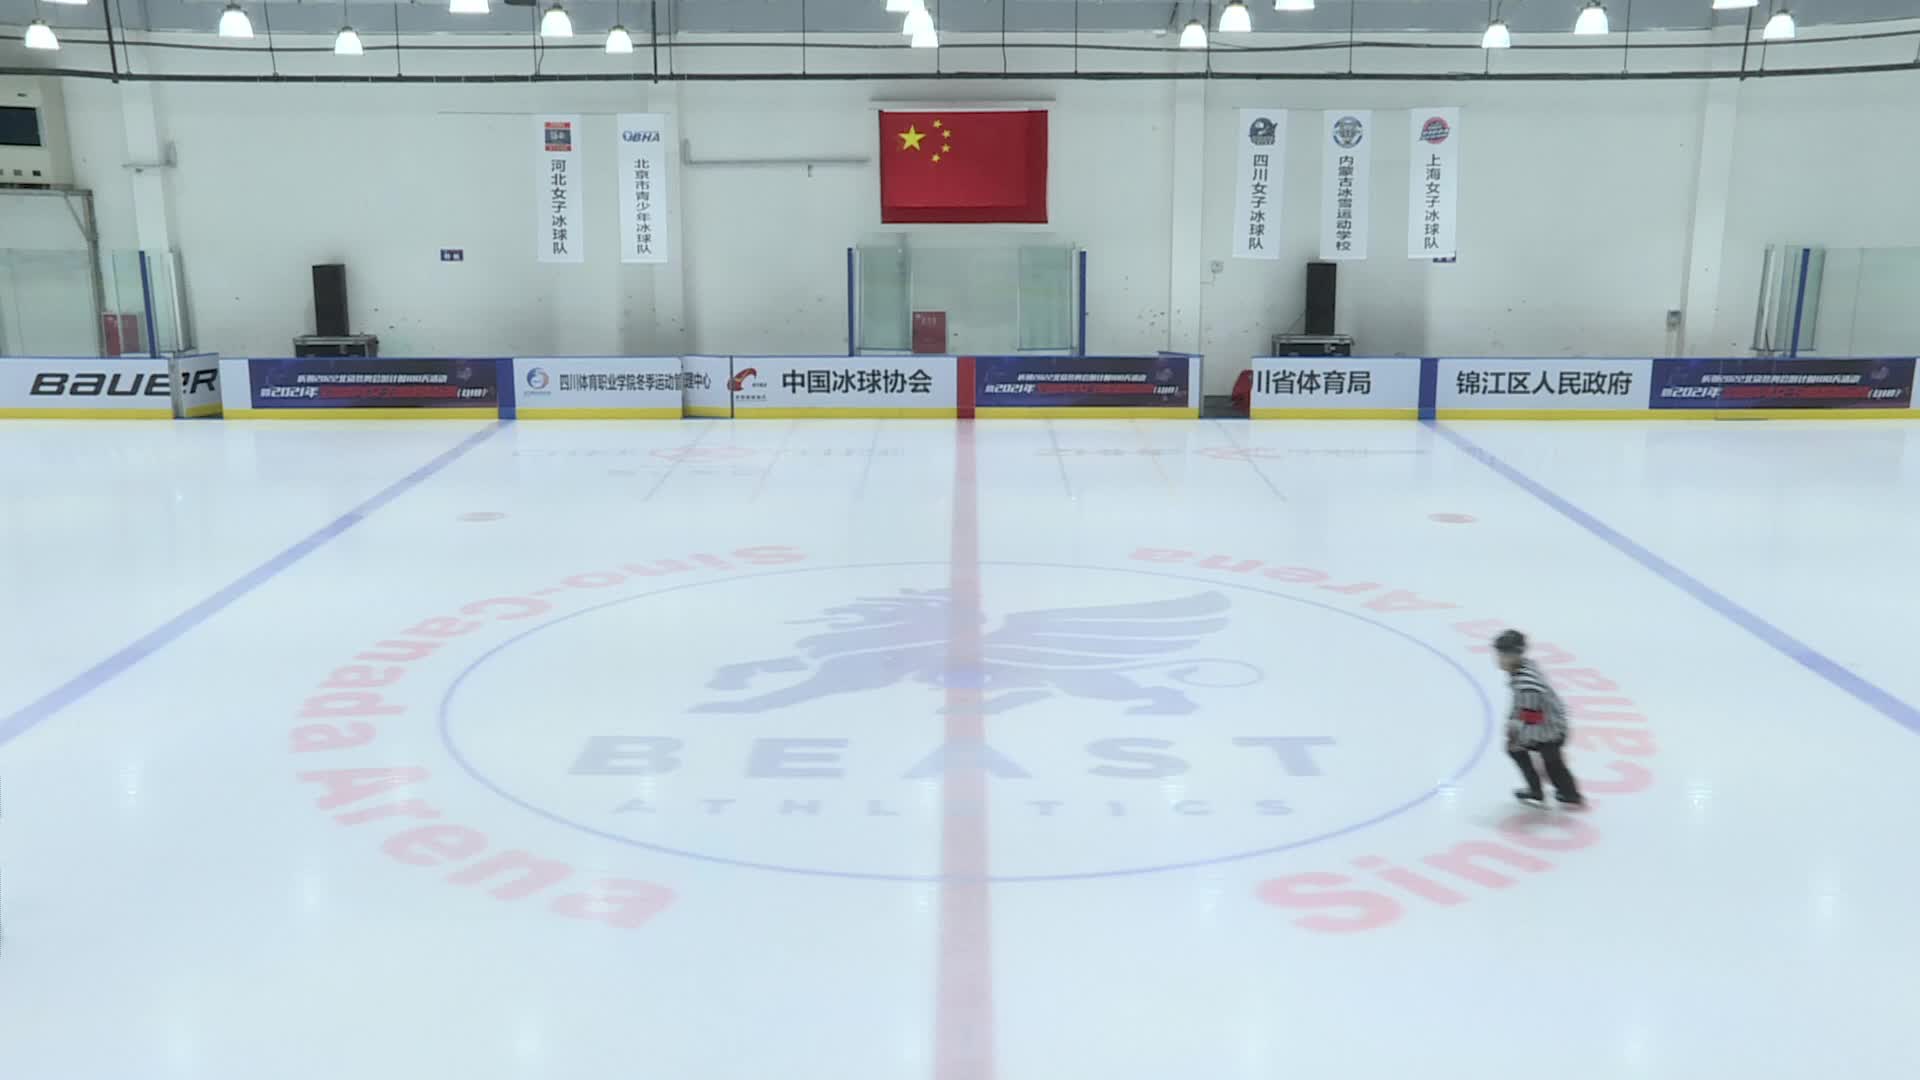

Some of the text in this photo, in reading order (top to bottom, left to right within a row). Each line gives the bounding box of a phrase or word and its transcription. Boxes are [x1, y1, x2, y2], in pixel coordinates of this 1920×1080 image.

[551, 159, 568, 255] 河北女子冰球队
[634, 158, 653, 255] 北京市青少年冰球队
[1248, 154, 1269, 251] 四川女子冰球队
[1336, 155, 1354, 251] 内蒙古冰雪运动学校
[1423, 153, 1442, 250] 上海女子冰球队
[781, 369, 933, 394] 中国冰球协会
[1456, 369, 1633, 396] 锦江区人民政府
[1129, 547, 1459, 613] Arena
[567, 735, 1337, 779] BEAST
[296, 766, 678, 930] Arena
[611, 798, 1294, 817] ATHLTICS
